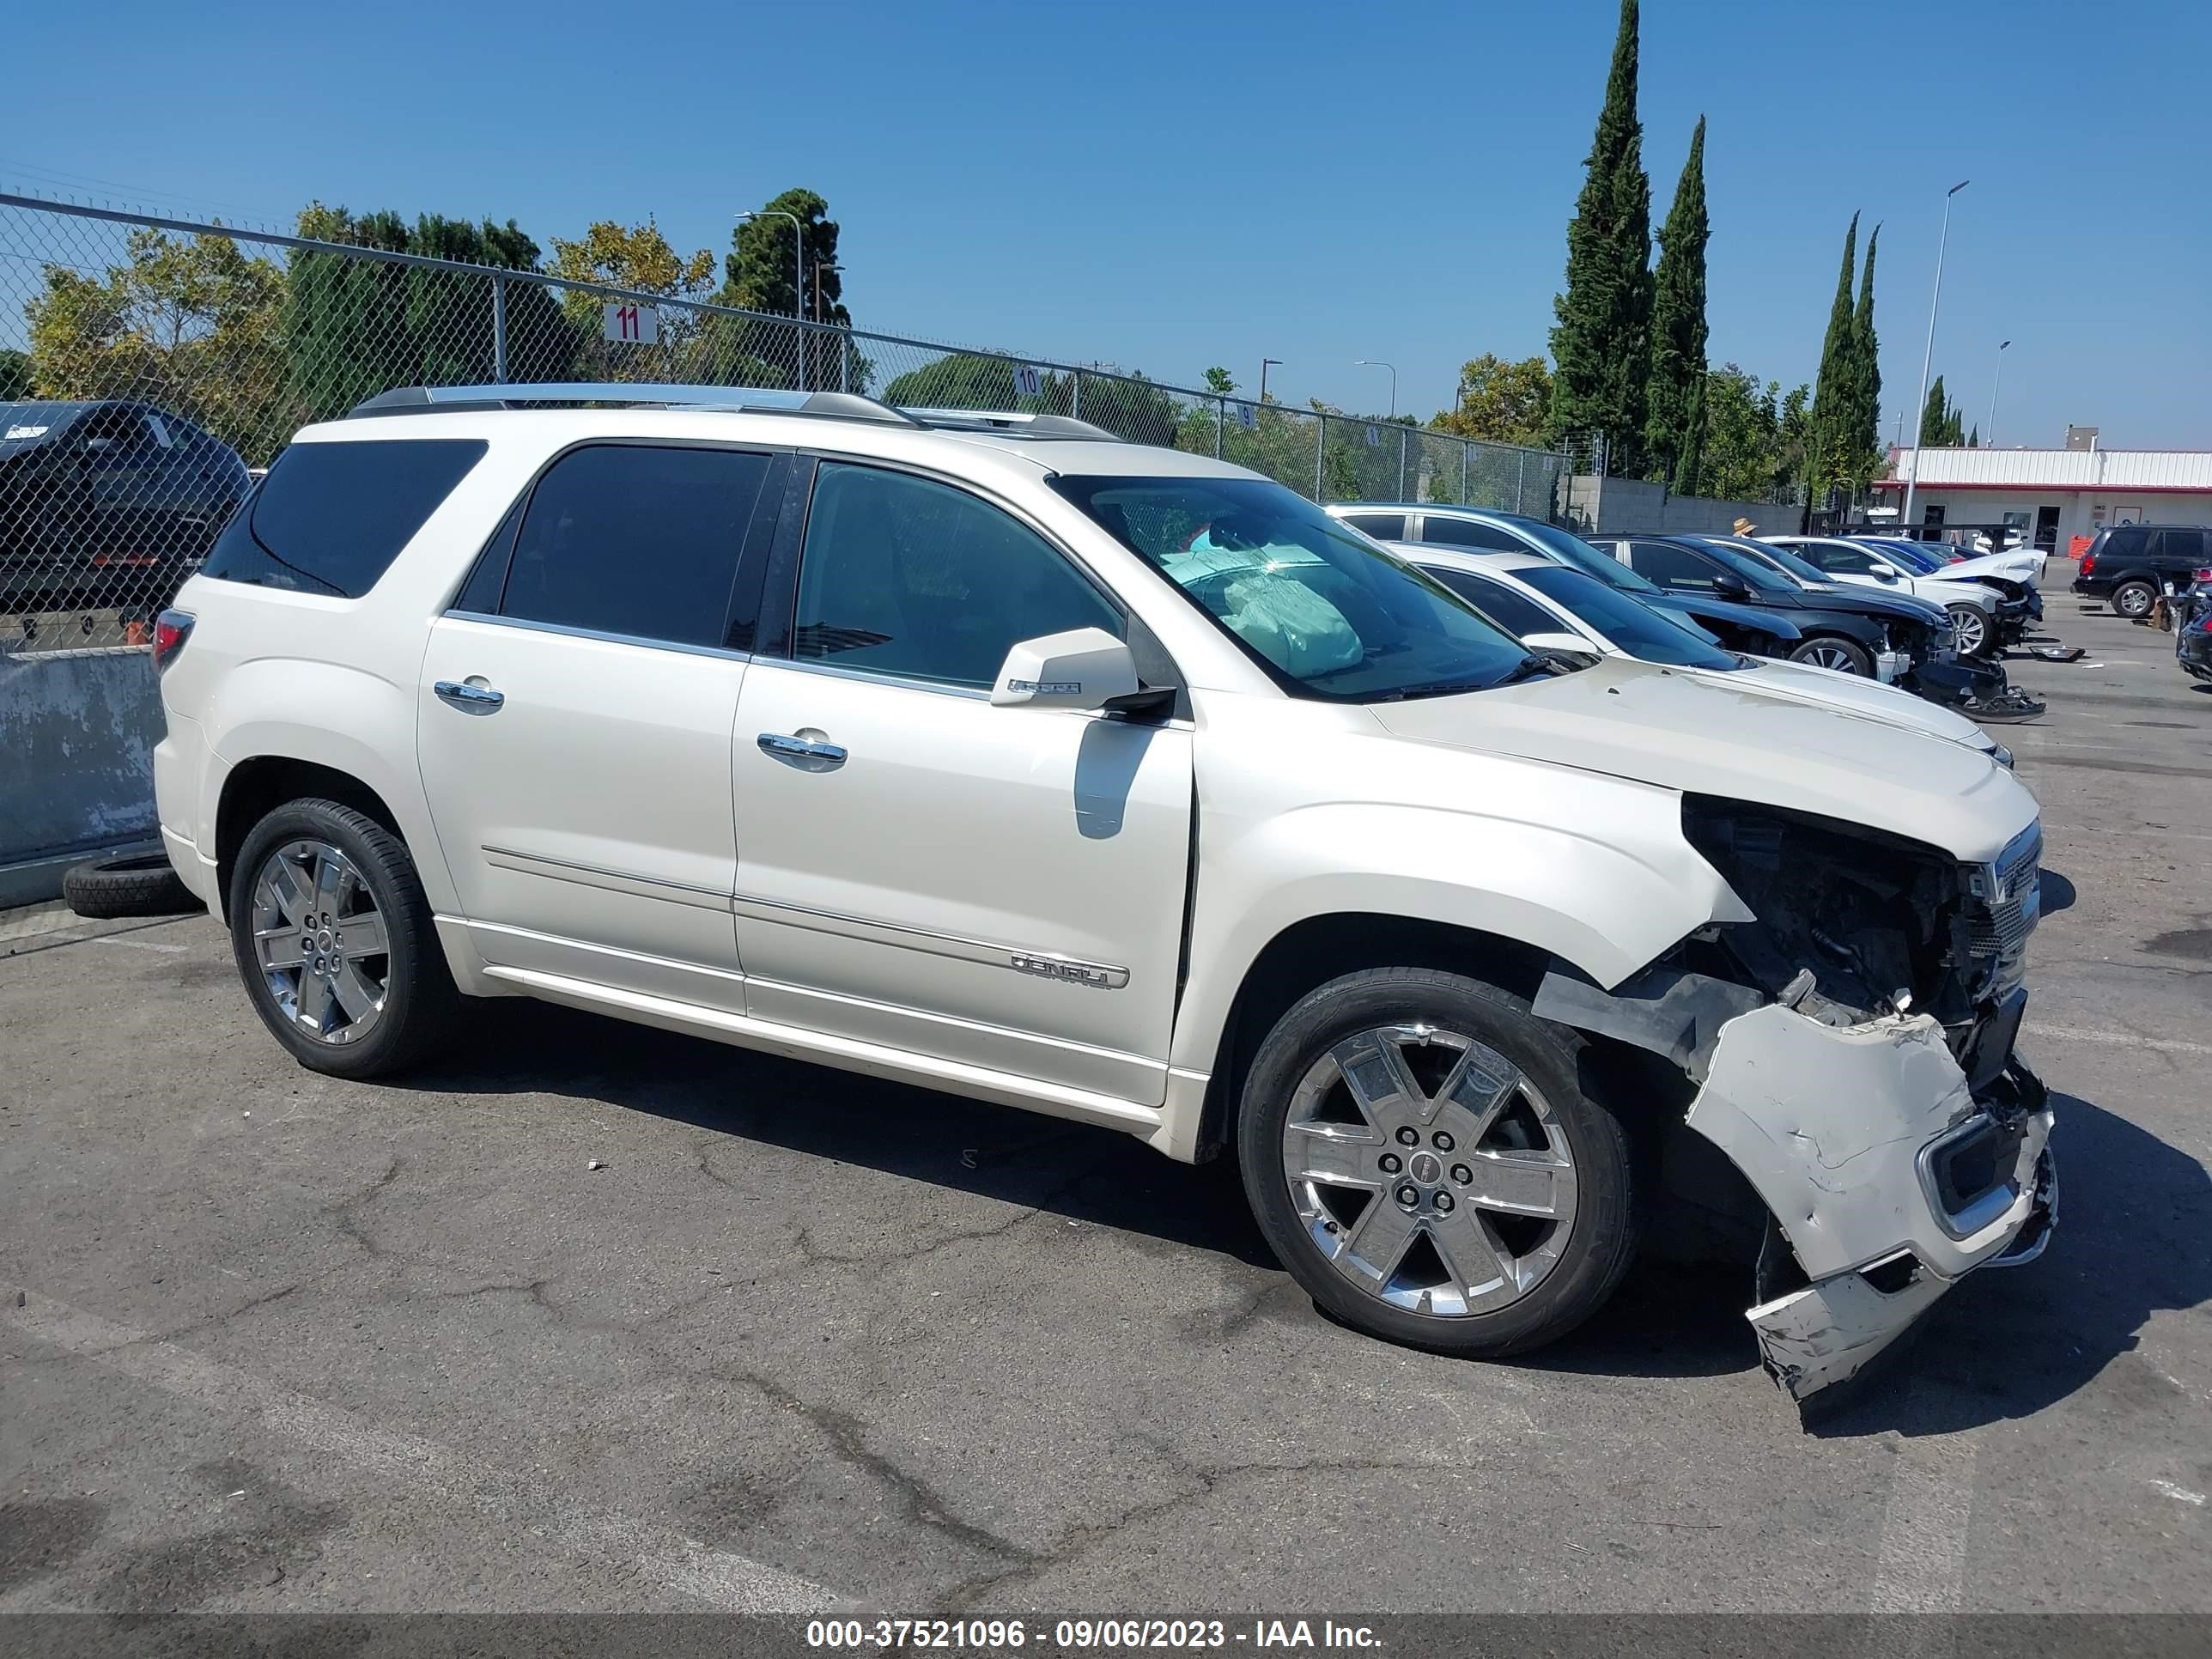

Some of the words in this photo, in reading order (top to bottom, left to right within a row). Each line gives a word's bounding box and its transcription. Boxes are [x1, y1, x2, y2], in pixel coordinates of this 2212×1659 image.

[617, 306, 640, 340] 11
[1019, 369, 1036, 393] 10
[1011, 953, 1108, 985] DENALI
